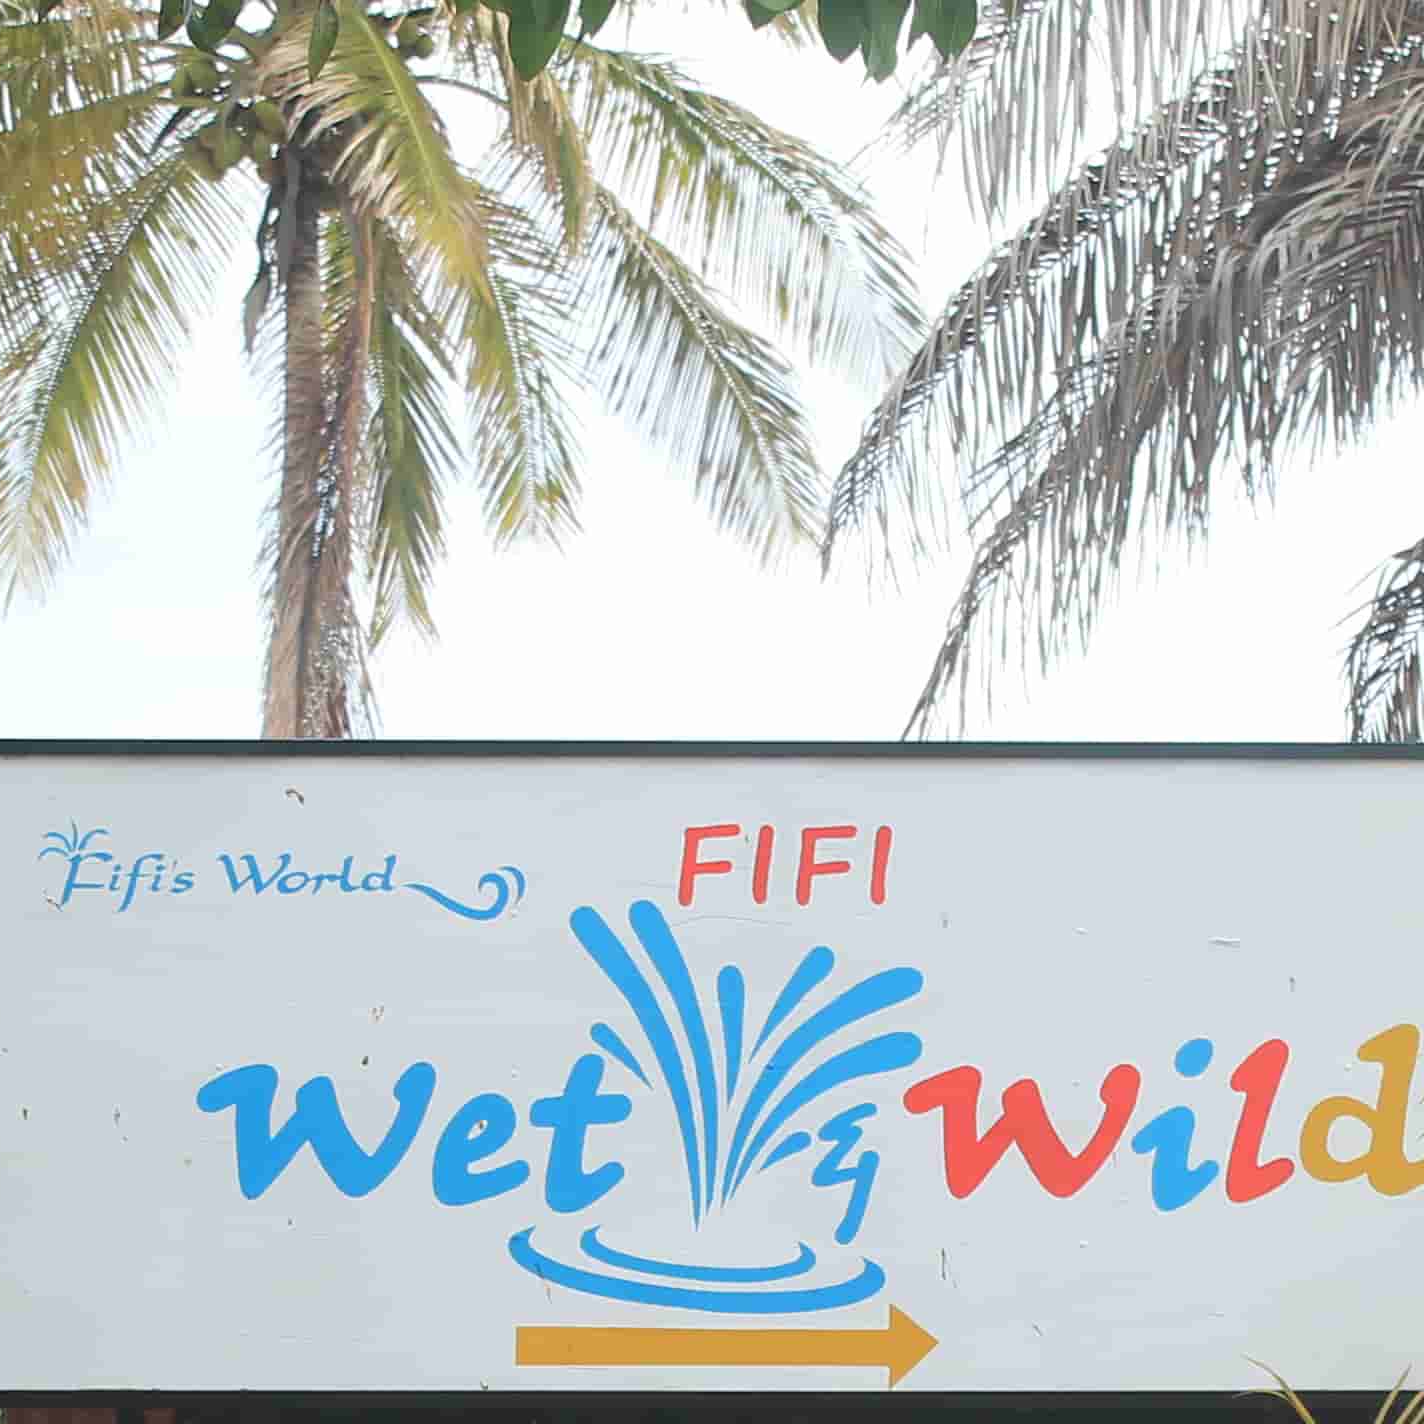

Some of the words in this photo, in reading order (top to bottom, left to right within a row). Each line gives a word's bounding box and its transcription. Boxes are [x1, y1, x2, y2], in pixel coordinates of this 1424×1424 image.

[217, 853, 397, 895] World
[678, 824, 892, 906] FIFI
[196, 1052, 633, 1213] Wet
[811, 1102, 880, 1245] &
